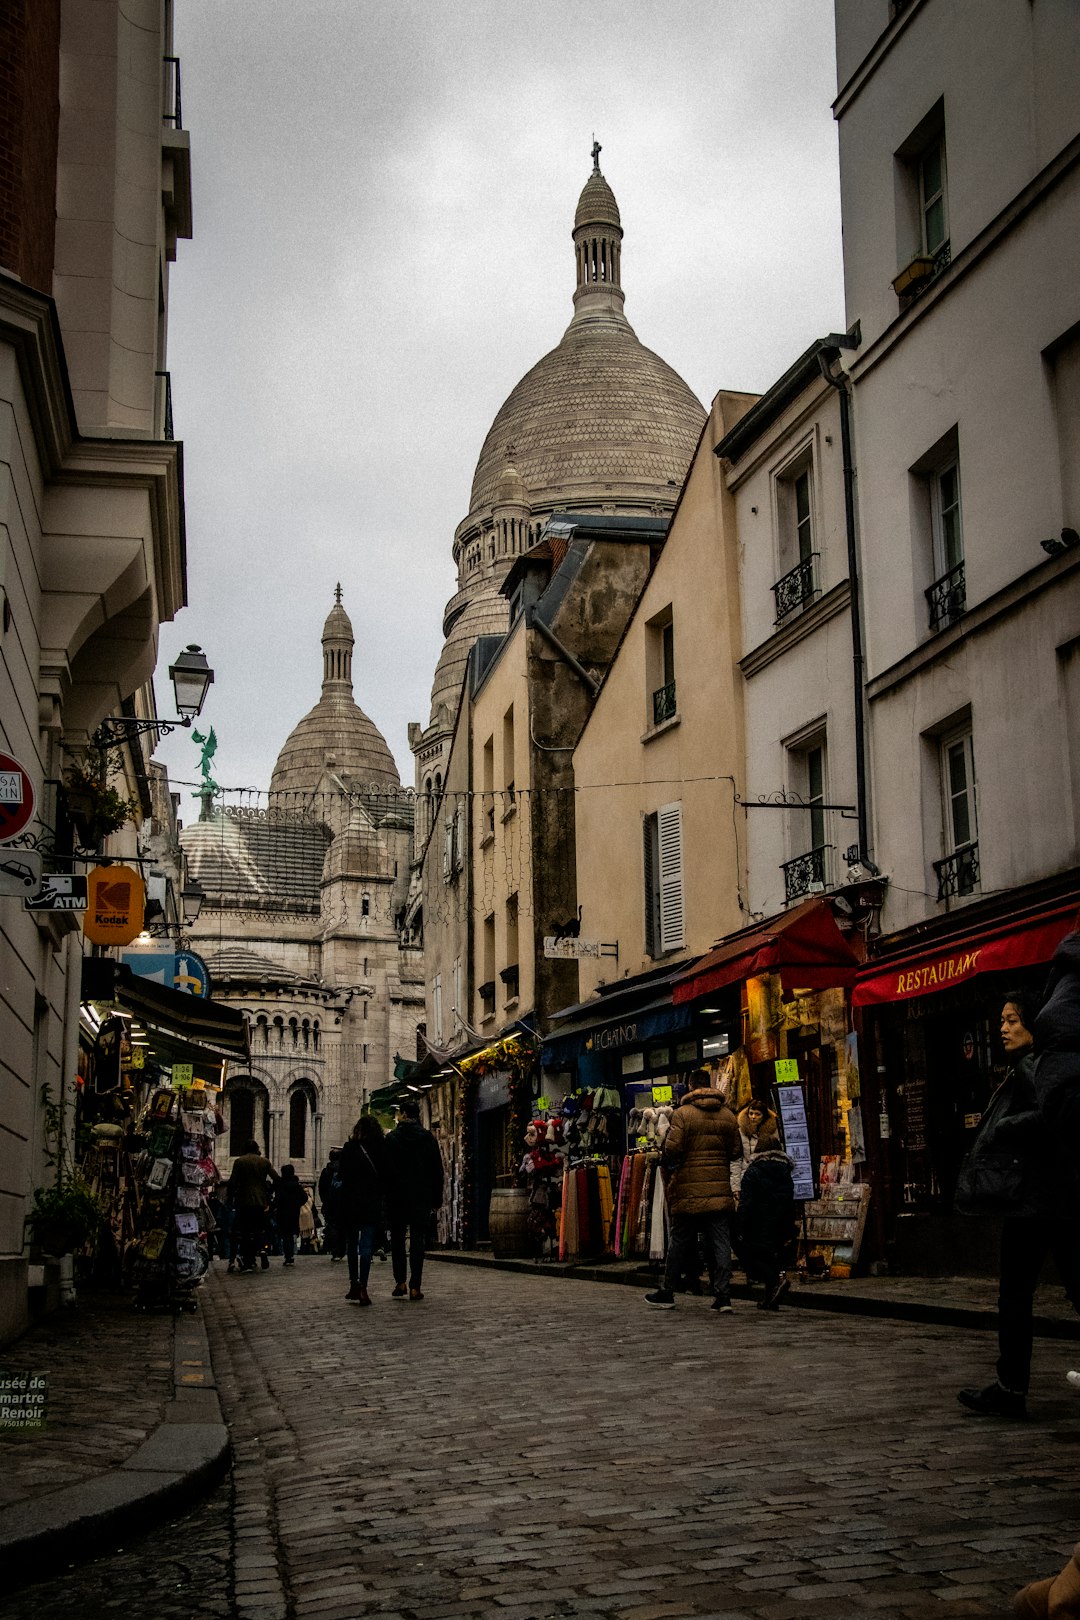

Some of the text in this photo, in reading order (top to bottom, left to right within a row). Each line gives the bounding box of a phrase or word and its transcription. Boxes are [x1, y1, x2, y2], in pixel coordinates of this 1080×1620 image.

[53, 897, 87, 909] ATM
[95, 914, 129, 925] Kodak
[29, 1377, 45, 1388] de
[0, 1393, 44, 1403] martre
[1, 1406, 43, 1418] Renoir
